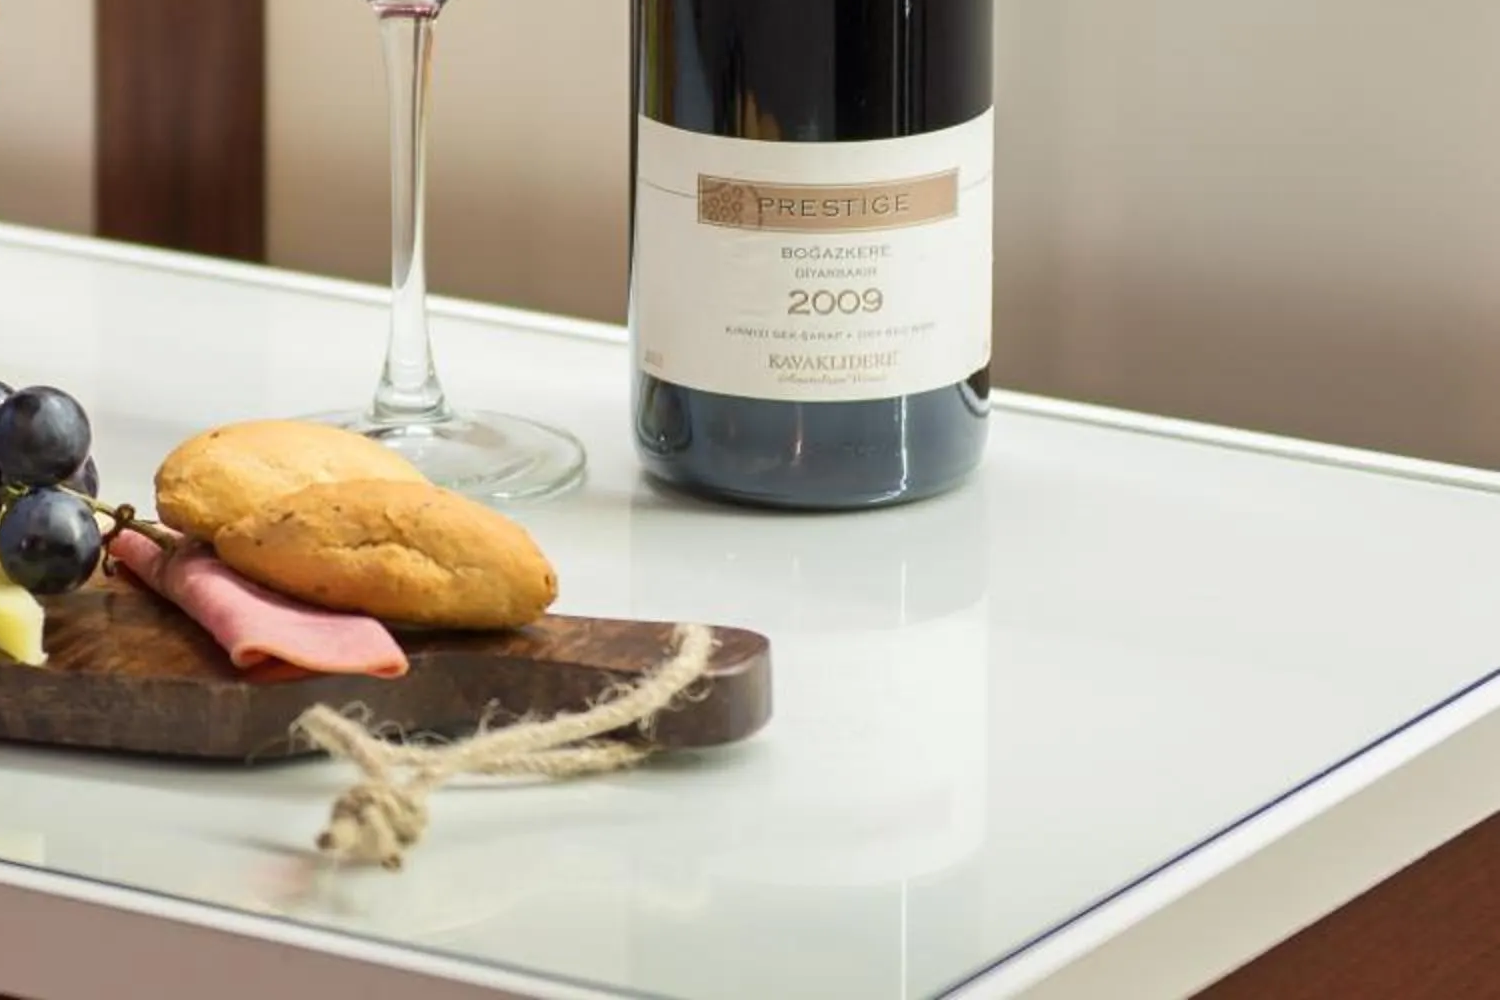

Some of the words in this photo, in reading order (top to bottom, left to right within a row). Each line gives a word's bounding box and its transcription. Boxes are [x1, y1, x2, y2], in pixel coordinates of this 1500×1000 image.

[758, 194, 910, 217] PRESTIGE
[781, 245, 892, 260] BOĞAZKERE
[787, 287, 883, 315] 2009
[768, 349, 901, 370] KAVAKLIDERE
